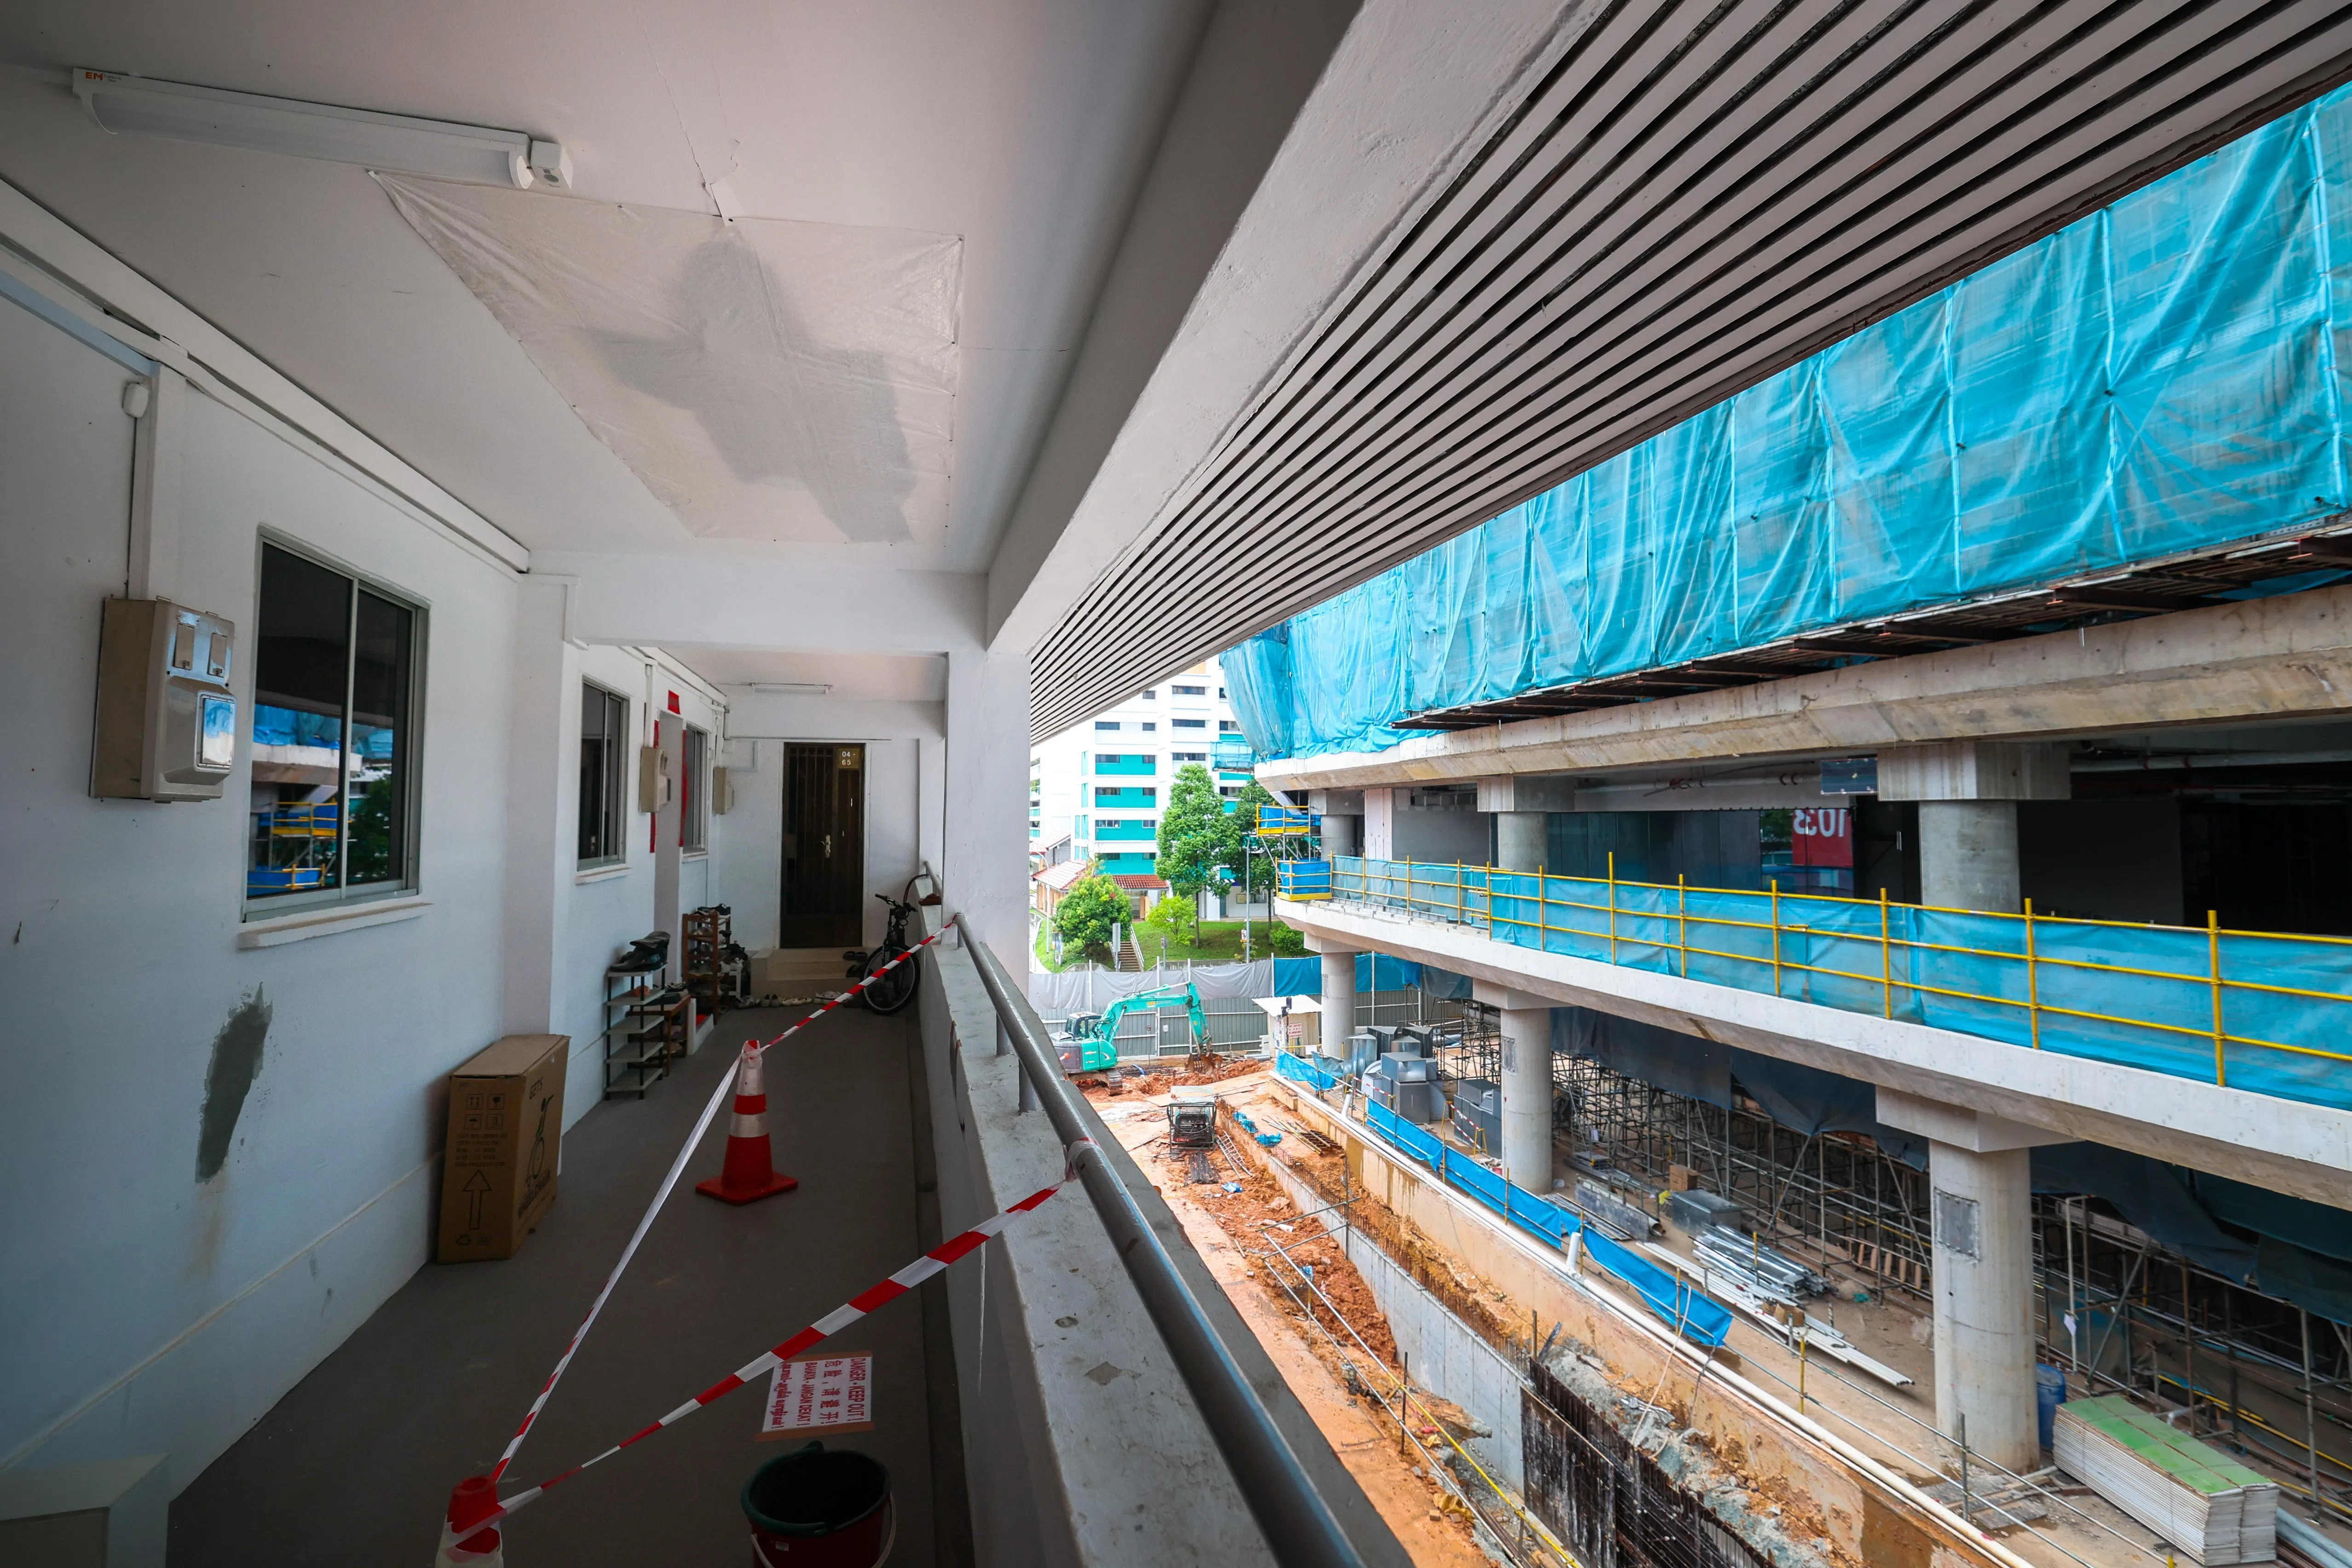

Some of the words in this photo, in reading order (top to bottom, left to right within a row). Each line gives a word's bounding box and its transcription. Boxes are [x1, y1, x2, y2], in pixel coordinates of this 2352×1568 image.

[85, 71, 104, 81] EM
[803, 1362, 818, 1381] BAHAYA
[850, 1358, 866, 1381] DANGER
[800, 1384, 814, 1403] JANGAN
[848, 1386, 865, 1402] KEEP
